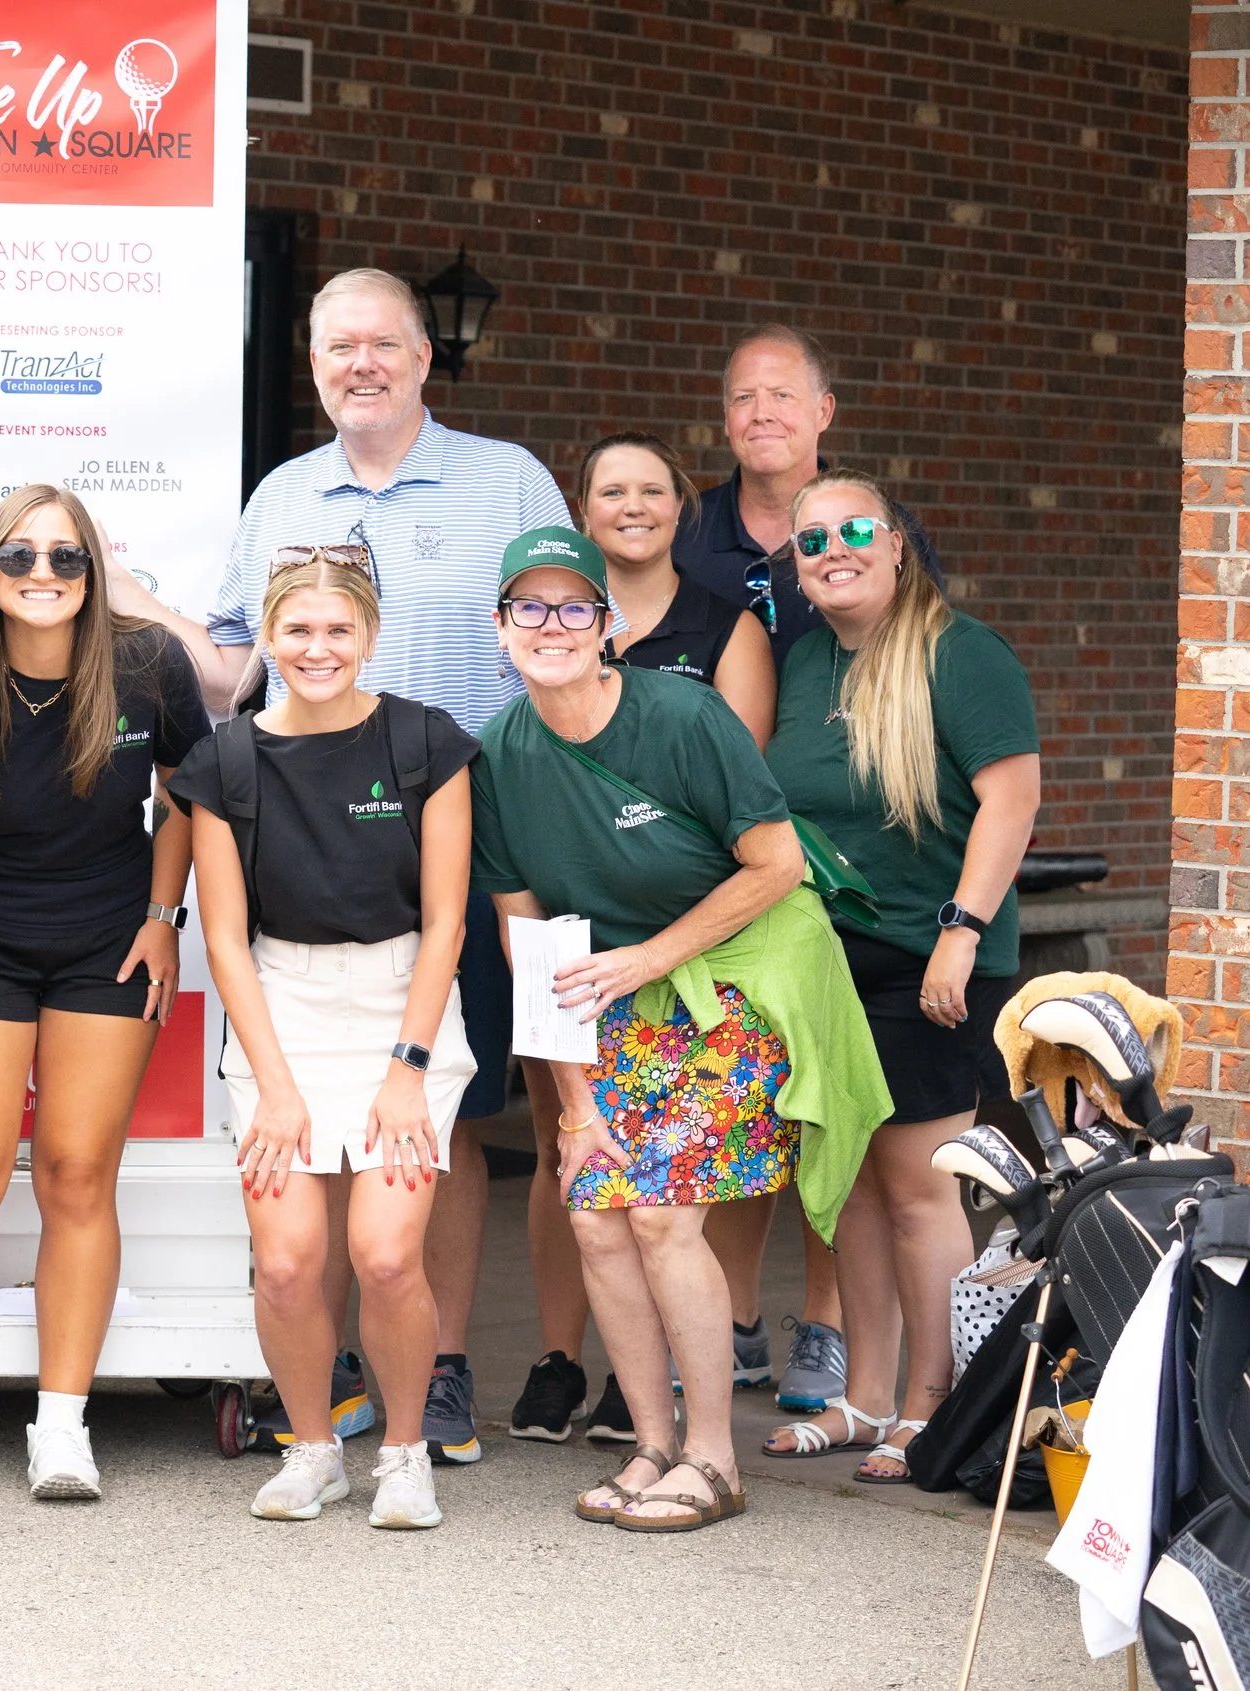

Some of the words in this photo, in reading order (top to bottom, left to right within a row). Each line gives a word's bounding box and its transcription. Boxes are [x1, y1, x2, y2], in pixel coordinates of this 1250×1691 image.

[26, 54, 102, 160] Up
[70, 131, 192, 159] SQUARE
[72, 163, 119, 176] CENTER
[55, 241, 111, 263] YOU
[119, 243, 152, 264] TO
[15, 270, 162, 293] SPONSORS!
[64, 326, 124, 337] SPONSOR
[1, 350, 104, 378] TranzAct
[6, 381, 75, 394] Technologies
[78, 382, 97, 392] Inc.
[0, 425, 36, 436] EVENT
[40, 425, 107, 437] SPONSORS
[78, 461, 101, 474] JO
[106, 461, 150, 474] ELLEN
[155, 462, 166, 474] &
[62, 478, 105, 491] SEAN
[110, 478, 182, 492] MADDEN
[537, 540, 571, 549] Choose
[527, 547, 551, 557] Main
[552, 547, 580, 558] Street
[684, 665, 704, 676] Bank
[125, 730, 150, 742] Bank
[349, 801, 380, 813] Fortifi
